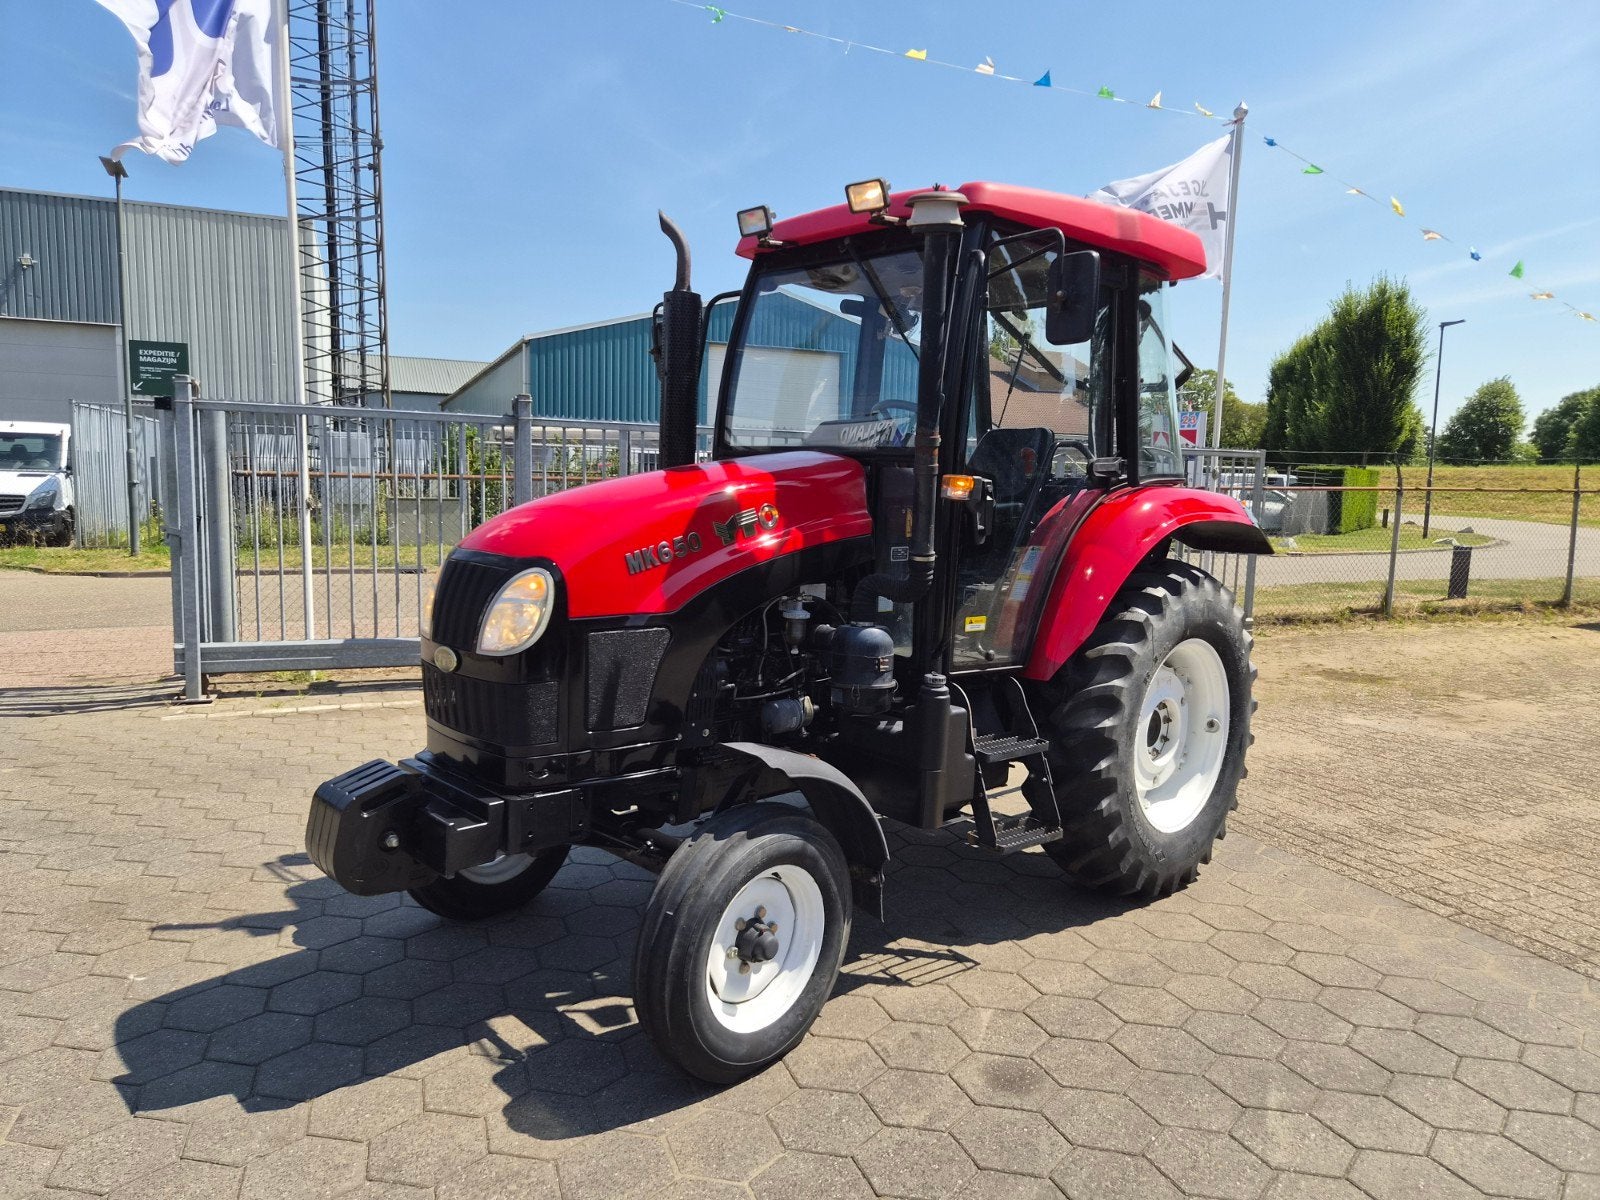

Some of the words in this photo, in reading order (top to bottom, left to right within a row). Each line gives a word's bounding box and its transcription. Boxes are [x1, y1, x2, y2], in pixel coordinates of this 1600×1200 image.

[139, 349, 175, 357] EXPEDITIE
[139, 356, 177, 364] MAGAZIJN
[713, 503, 779, 545] YTO
[625, 532, 703, 575] MK650
